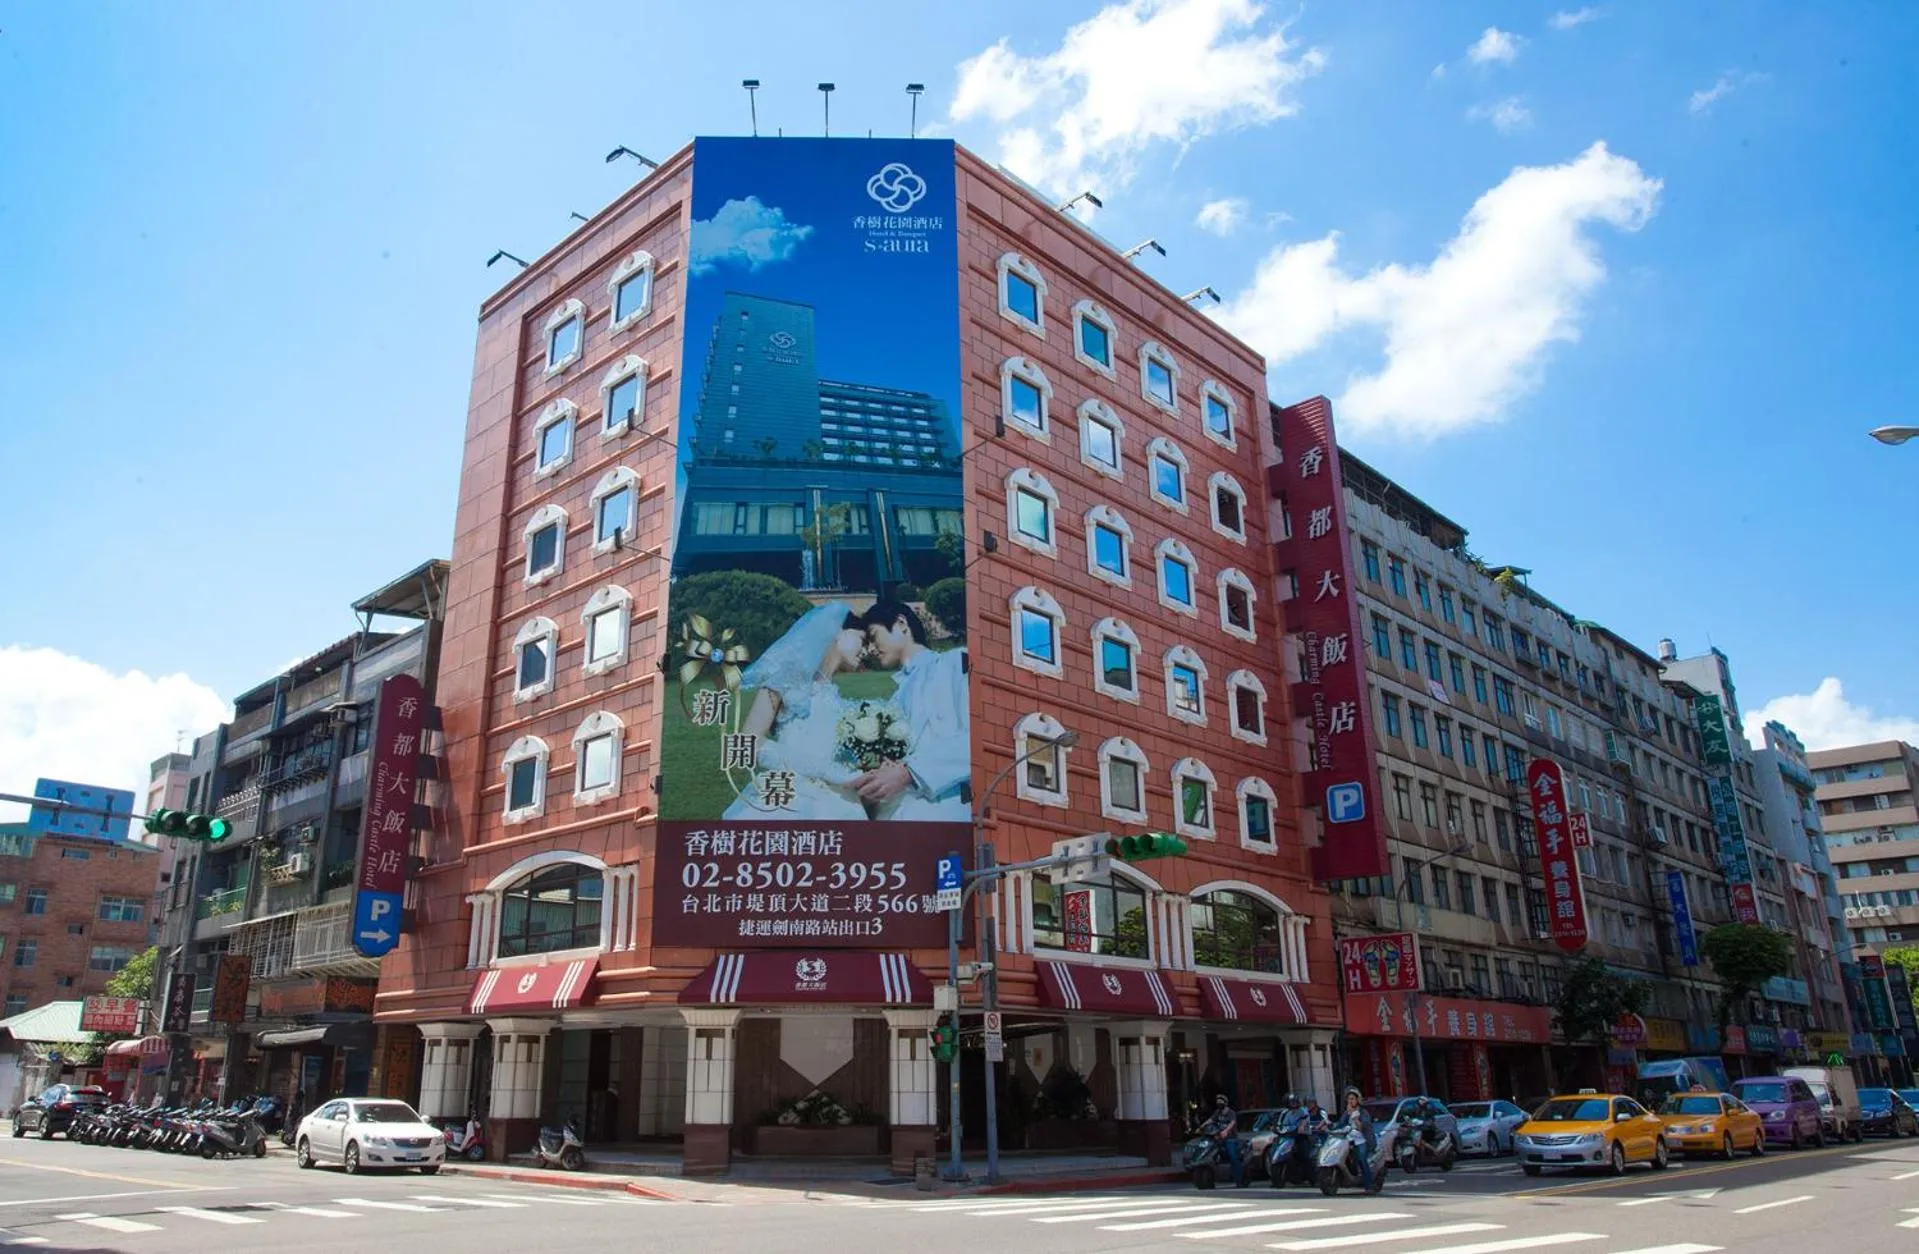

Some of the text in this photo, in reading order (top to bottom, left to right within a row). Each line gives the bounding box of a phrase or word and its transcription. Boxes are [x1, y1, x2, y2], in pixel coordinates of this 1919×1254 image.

[1299, 445, 1356, 736] 香都大飯店
[377, 696, 419, 876] 香都大飯店
[1334, 788, 1359, 819] P
[684, 830, 844, 857] 香樹花園酒店
[681, 861, 908, 891] 02-8502-3955
[938, 859, 951, 879] P
[371, 899, 391, 921] P
[1342, 941, 1361, 965] 24
[1348, 968, 1362, 991] H
